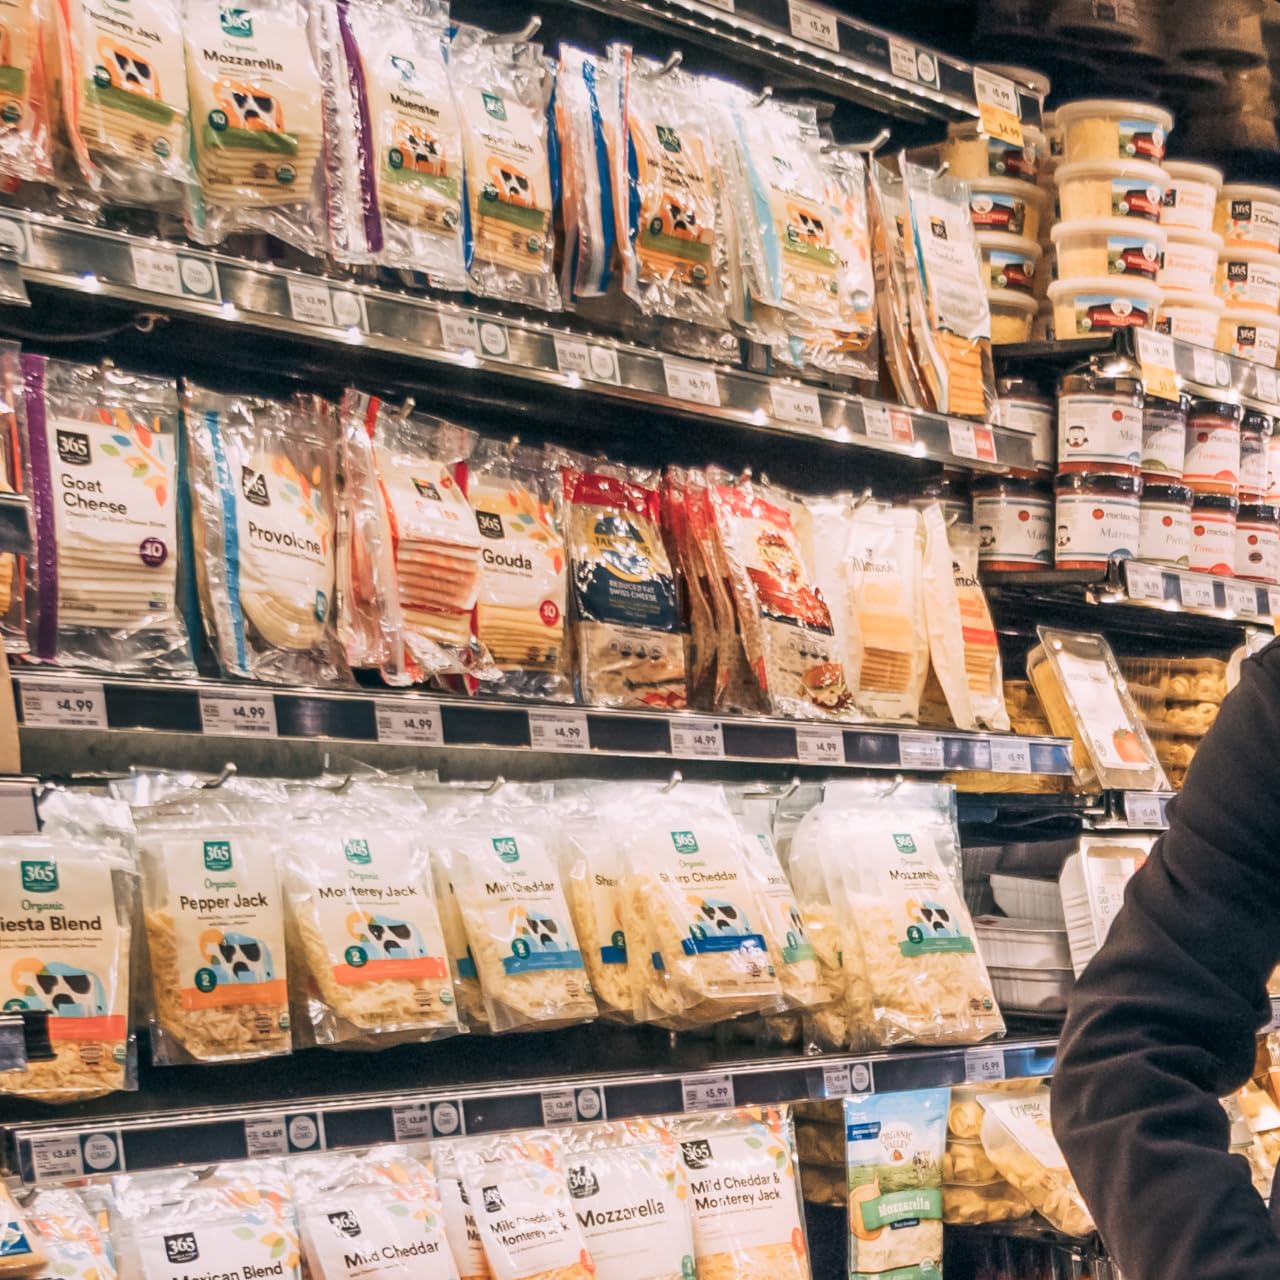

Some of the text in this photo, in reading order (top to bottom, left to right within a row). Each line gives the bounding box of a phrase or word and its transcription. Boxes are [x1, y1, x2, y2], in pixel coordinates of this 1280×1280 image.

[203, 49, 284, 71] Mozzarella
[390, 92, 440, 117] Muenster
[60, 436, 88, 456] 365
[61, 473, 103, 494] Goat
[62, 492, 128, 515] Cheese
[479, 514, 501, 531] 365
[482, 549, 533, 570] Gouda
[609, 579, 641, 593] REDUCED
[543, 605, 557, 618] 10
[57, 698, 94, 713] $4.99
[234, 706, 265, 719] $4.99
[404, 718, 432, 731] $4.99
[555, 727, 580, 739] $4.99
[693, 735, 717, 746] $4.99
[816, 742, 837, 753] $4.99
[675, 833, 695, 847] 365
[897, 835, 913, 848] 365
[206, 845, 230, 861] 365
[496, 841, 516, 856] 365
[24, 865, 55, 882] 365
[692, 870, 738, 882] Cheddar
[204, 878, 238, 891] Organic
[387, 885, 418, 898] Jack
[21, 899, 65, 913] Organic
[180, 892, 269, 914] Pepper Jack
[0, 915, 103, 932] iesta Blend
[352, 950, 361, 963] 2
[202, 974, 211, 986] 2
[981, 1061, 1000, 1072] $5.99
[705, 1087, 728, 1099] $5.99
[880, 1130, 912, 1145] ORGANIC
[884, 1139, 909, 1151] VALLEY
[724, 1174, 771, 1190] Cheddar
[772, 1172, 781, 1184] &
[695, 1188, 782, 1211] Monterey Jack
[576, 1198, 665, 1228] Mozzarella
[878, 1197, 930, 1218] Mozzarella
[168, 1240, 196, 1255] 365
[382, 1240, 440, 1259] Cheddar
[242, 1261, 283, 1279] Blend
